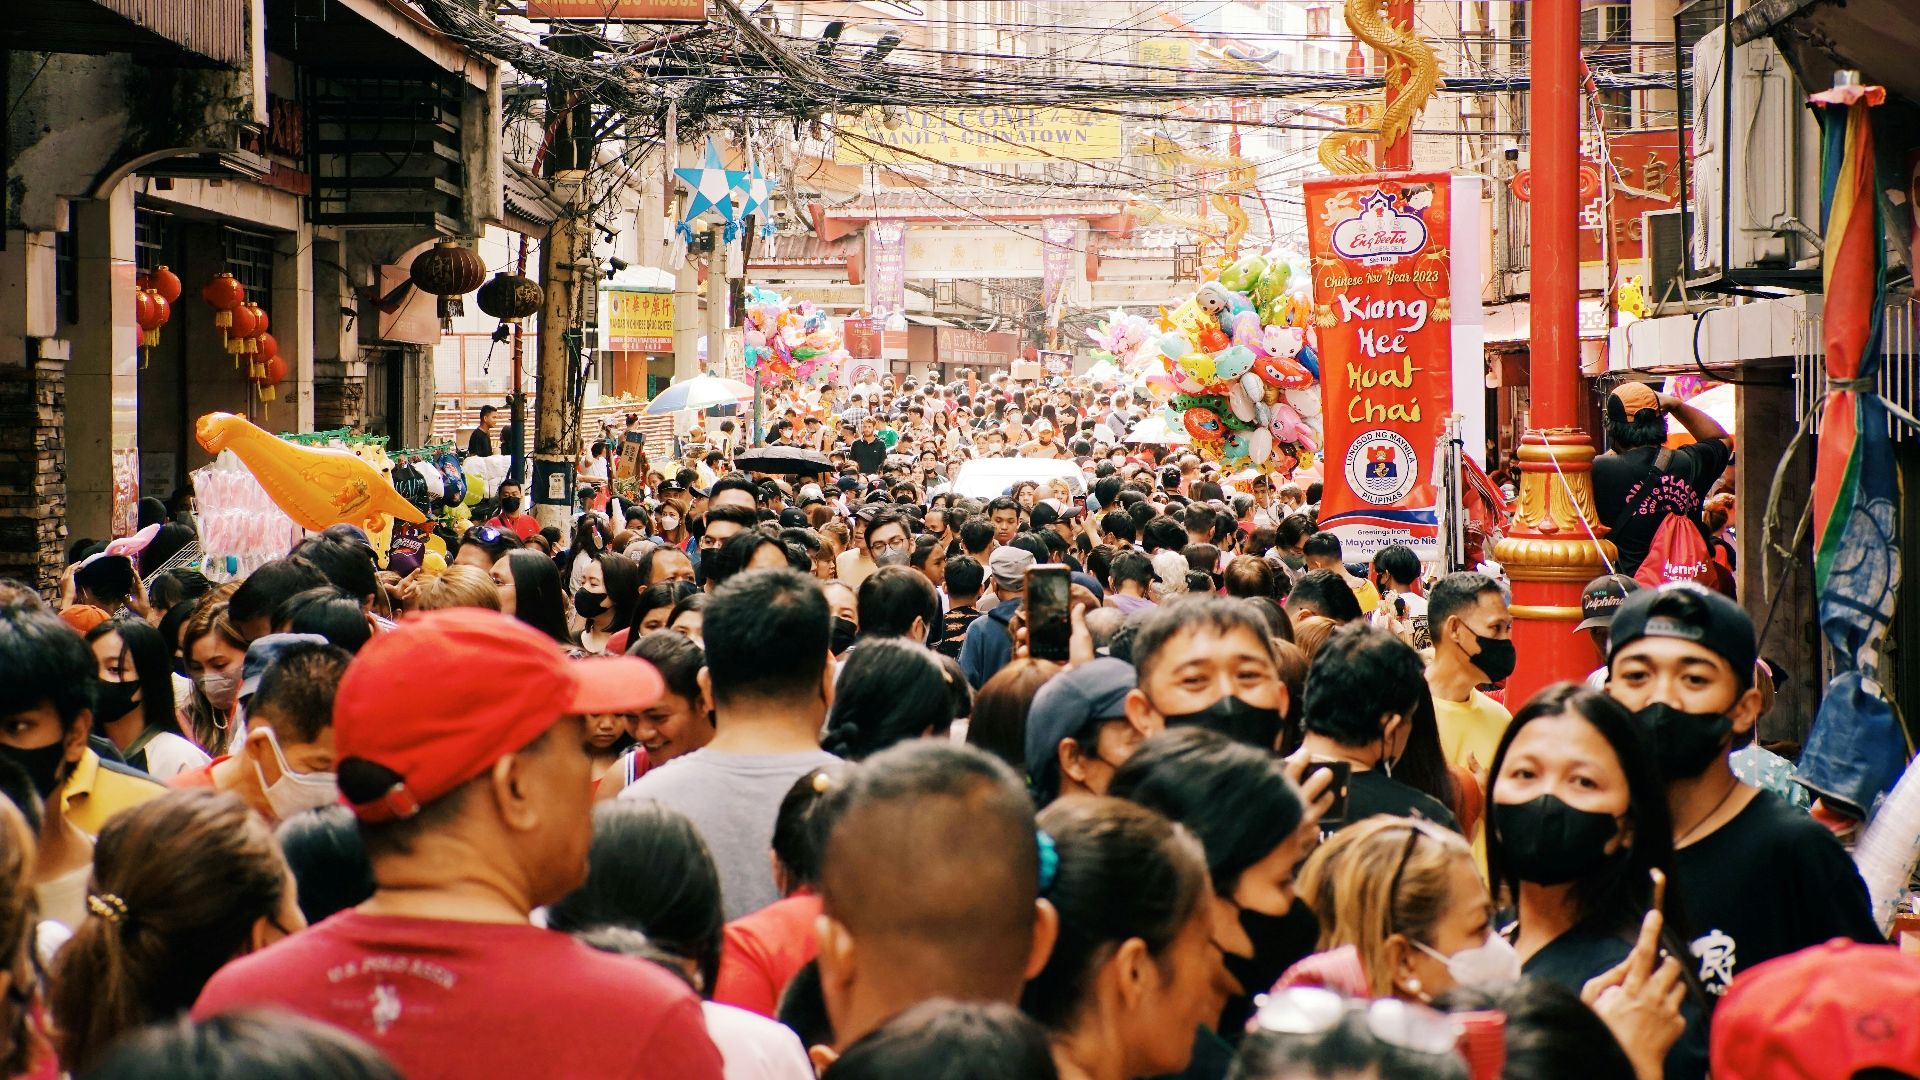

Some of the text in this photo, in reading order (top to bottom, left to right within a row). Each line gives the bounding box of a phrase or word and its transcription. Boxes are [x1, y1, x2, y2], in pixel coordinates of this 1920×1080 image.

[960, 129, 1087, 144] CHINATOWN
[1350, 230, 1408, 249] Eng Bee Tin
[1324, 274, 1363, 288] Chinese
[1385, 270, 1411, 285] Year
[1413, 270, 1439, 283] 2023
[1337, 293, 1427, 332] Kiong
[1357, 327, 1408, 357] Hee
[1346, 355, 1424, 392] Huat
[1348, 395, 1421, 424] Chai
[1346, 433, 1373, 466] LUNGSOD
[1389, 433, 1416, 463] MAYNILA
[1362, 491, 1403, 503] PILIPINAS
[1345, 538, 1374, 548] Mayor
[1392, 537, 1419, 545] Servo
[1664, 558, 1707, 578] Henry's
